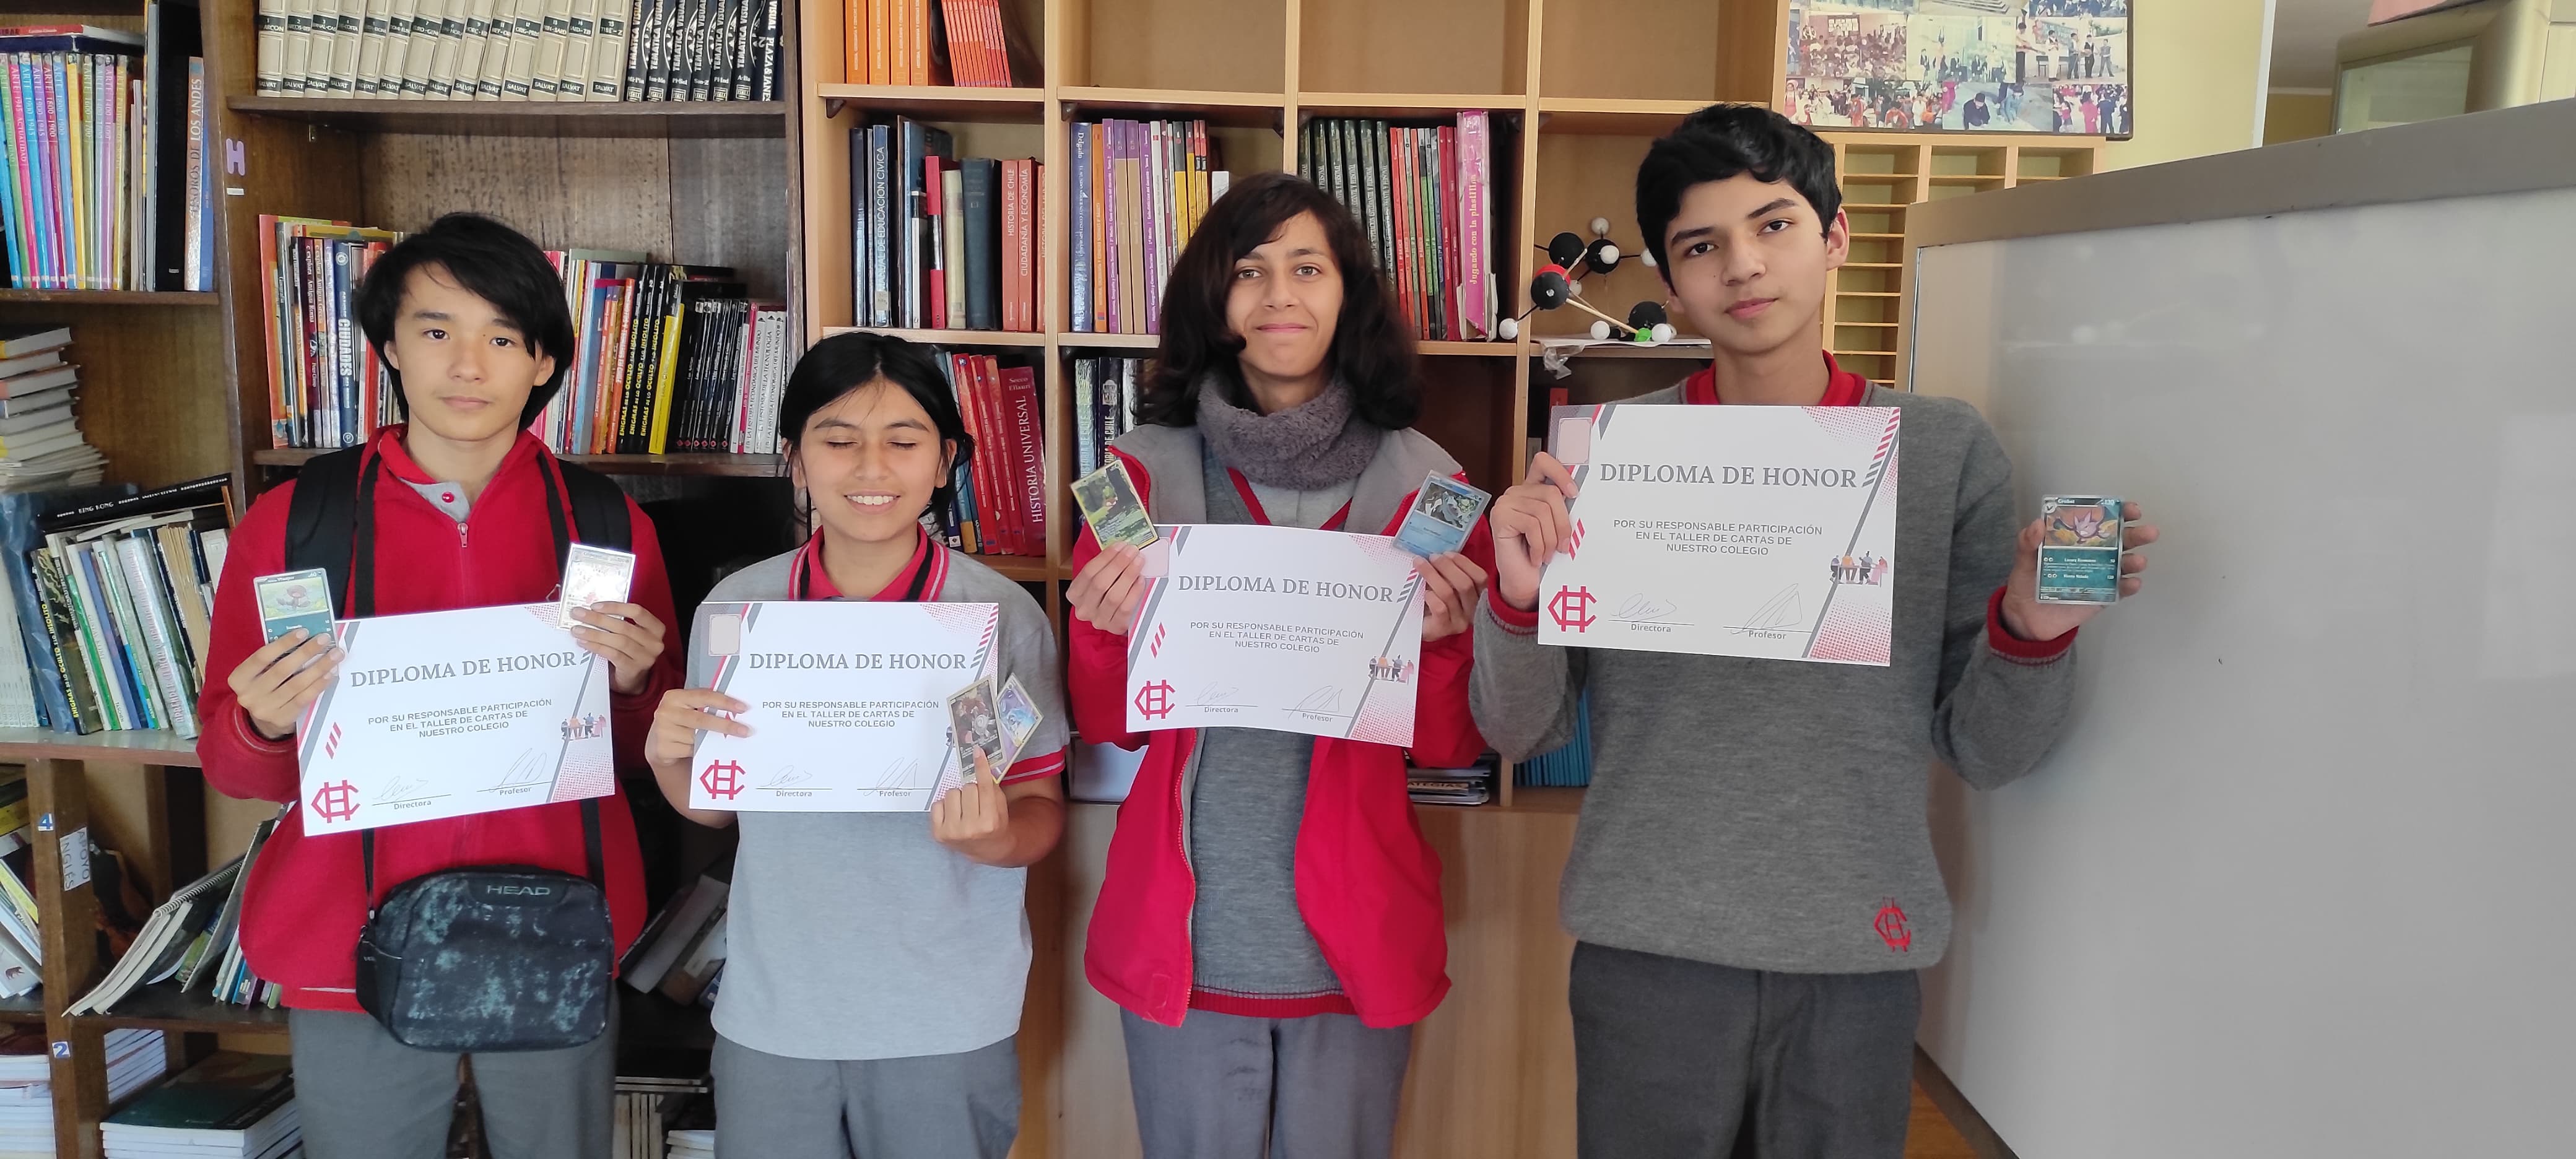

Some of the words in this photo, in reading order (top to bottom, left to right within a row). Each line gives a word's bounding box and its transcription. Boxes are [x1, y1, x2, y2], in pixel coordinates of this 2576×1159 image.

[765, 37, 774, 66] PLAZA
[11, 68, 20, 90] ARTE
[43, 67, 53, 90] ARTE
[456, 83, 474, 92] SALVAT
[534, 82, 555, 90] SALVAT
[562, 83, 581, 92] SALVAT
[191, 78, 202, 116] ANDES
[507, 84, 527, 93] SALVAT
[190, 119, 201, 141] LOS
[226, 138, 245, 176] H
[877, 146, 885, 180] CIVICA
[1008, 190, 1014, 200] DE
[876, 181, 886, 238] EDUCACION
[1469, 219, 1477, 228] la
[1469, 248, 1479, 284] Jugando
[339, 319, 352, 376] CIUDADES
[619, 406, 628, 436] ENIGMAS
[624, 363, 633, 391] OCULTO
[629, 405, 638, 435] ENIGMAS
[635, 362, 644, 389] OCULTO
[640, 406, 649, 436] ENIGMAS
[646, 363, 655, 391] OCULTO
[1016, 396, 1034, 463] UNIVERSAL
[1105, 415, 1115, 435] CHILE
[1600, 464, 1715, 484] DIPLOMA
[1722, 466, 1755, 485] DE
[1762, 467, 1857, 488] HONOR
[1026, 466, 1043, 523] HISTORIA
[1614, 519, 1636, 529] POR
[1638, 520, 1653, 529] SU
[1656, 521, 1735, 532] RESPONSABLE
[1738, 524, 1822, 535] PARTICIPACIÓN
[1635, 531, 1650, 540] EN
[1669, 532, 1710, 542] TALLER
[1713, 534, 1728, 542] DE
[1730, 534, 1774, 544] CARTAS
[1777, 536, 1792, 545] DE
[1666, 543, 1717, 553] NUESTRO
[1720, 545, 1769, 556] COLEGIO
[1178, 576, 1276, 593] DIPLOMA
[1282, 578, 1309, 595] DE
[1316, 581, 1393, 602] HONOR
[1226, 622, 1293, 633] RESPONSABLE
[1630, 623, 1671, 633] Directora
[1749, 630, 1786, 640] Profesor
[1235, 640, 1277, 649] NUESTRO
[1280, 643, 1320, 653] COLEGIO
[1237, 632, 1272, 640] TALLER
[1288, 635, 1325, 645] CARTAS
[350, 662, 456, 688] DIPLOMA
[463, 659, 491, 675] DE
[497, 651, 577, 672] HONOR
[750, 654, 849, 669] DIPLOMA
[855, 654, 882, 669] DE
[889, 654, 966, 669] HONOR
[368, 717, 389, 725] POR
[407, 706, 478, 721] RESPONSABLE
[481, 698, 552, 712] PARTICIPACIÓN
[869, 700, 939, 708] PARTICIPACIÓN
[390, 723, 403, 732] EN
[406, 722, 418, 730] EL
[420, 718, 457, 729] TALLER
[475, 713, 513, 723] CARTAS
[1302, 713, 1333, 723] Profesor
[419, 726, 464, 738] NUESTRO
[467, 721, 509, 732] COLEGIO
[499, 786, 532, 796] Profesor
[394, 800, 432, 810] Directora
[39, 812, 53, 830] 4
[77, 831, 90, 880] APOYO
[487, 885, 550, 895] HEAD
[54, 1042, 67, 1057] 2
